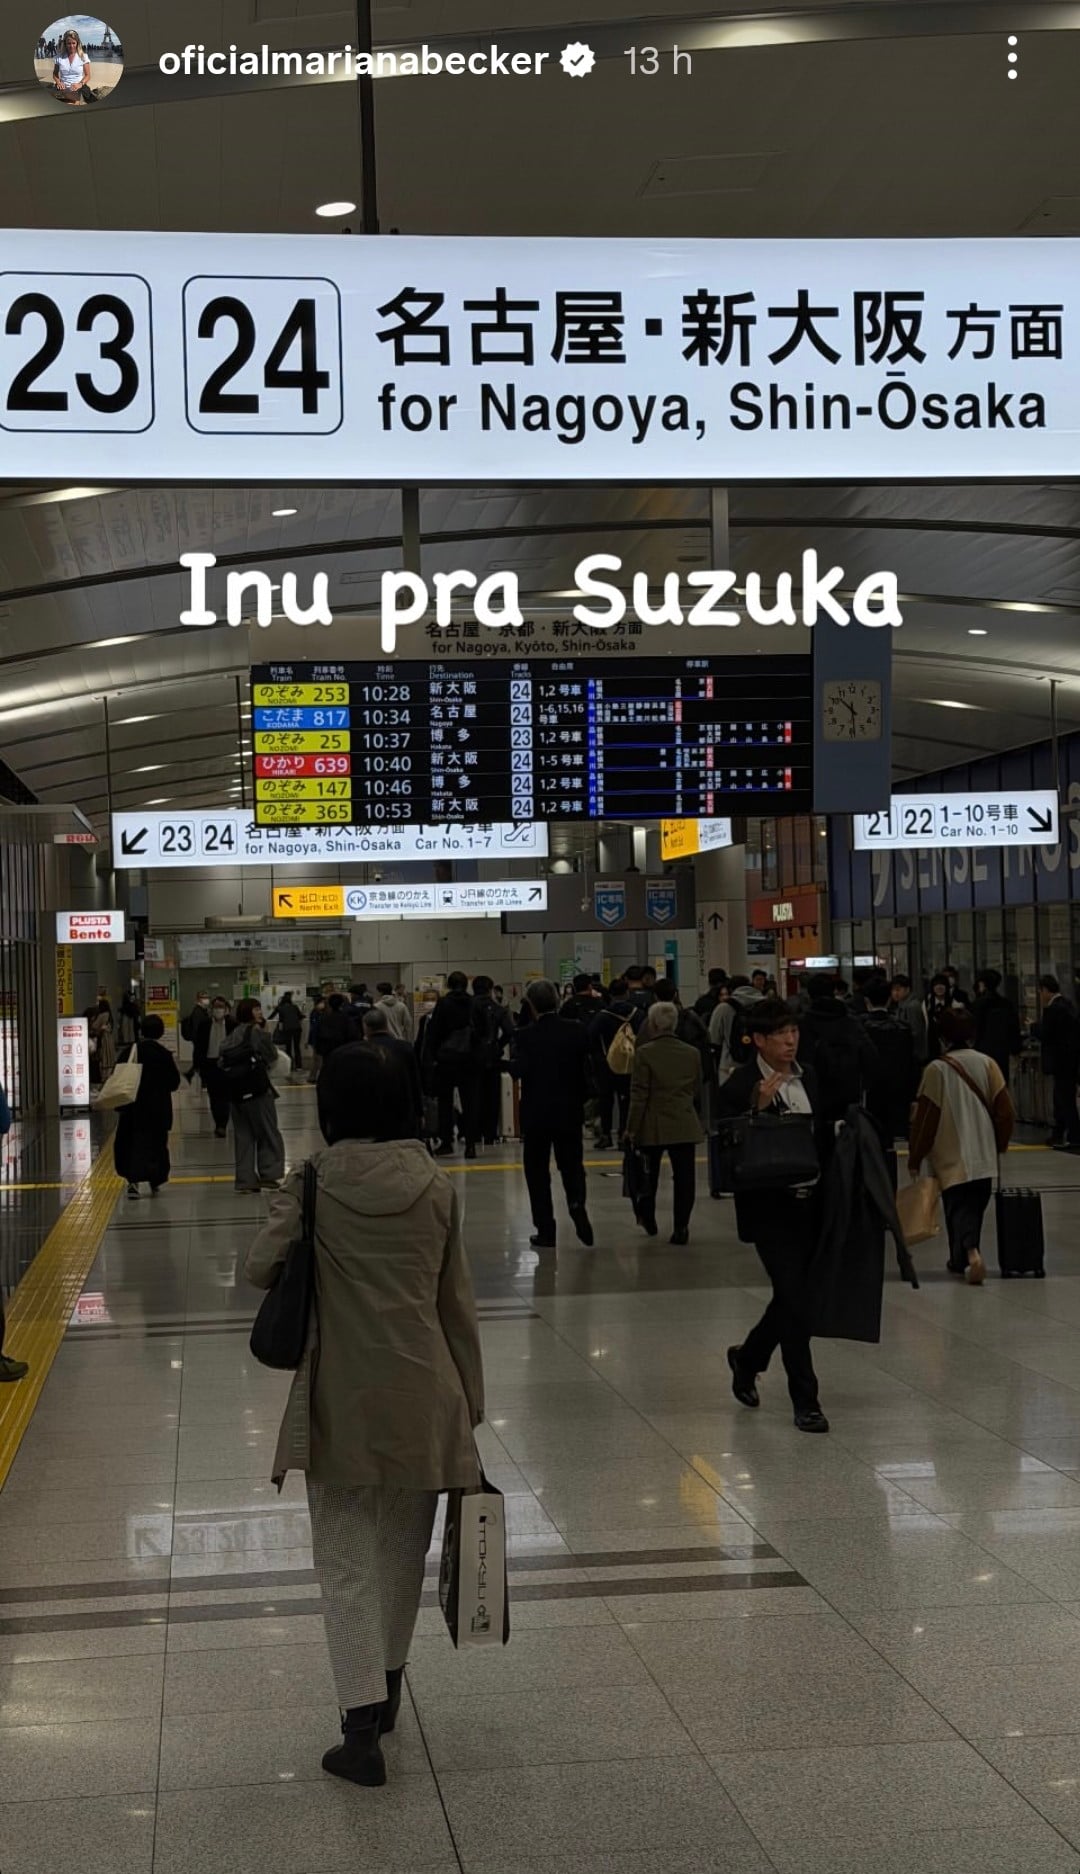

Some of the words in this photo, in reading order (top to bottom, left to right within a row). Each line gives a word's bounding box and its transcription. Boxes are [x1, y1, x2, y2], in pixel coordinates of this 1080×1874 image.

[946, 302, 1064, 360] 方面
[5, 292, 139, 414] 23
[198, 296, 329, 414] 24
[378, 383, 457, 431] for
[481, 382, 706, 444] Nagoya,
[730, 371, 1046, 431] Shin-Ōsaka
[432, 642, 453, 654] for
[456, 641, 512, 656] Nagoya,
[260, 686, 304, 698] のぞみ
[313, 687, 346, 702] 253
[362, 686, 411, 702] 10:28
[513, 682, 531, 700] 24
[539, 685, 556, 697] 1,2
[559, 685, 582, 696] 号車
[262, 708, 304, 722] こだま
[513, 706, 531, 723] 24
[539, 703, 584, 716] 1-6,15,16
[314, 710, 346, 725] 817
[363, 710, 411, 725] 10:34
[261, 733, 306, 745] のぞみ
[320, 735, 341, 750] 25
[363, 734, 411, 748] 10:37
[513, 728, 531, 746] 23
[540, 731, 556, 744] 1,2
[560, 731, 582, 743] 号車
[262, 756, 306, 769] ひかり
[314, 757, 348, 773] 639
[364, 757, 412, 772] 10:40
[513, 752, 531, 770] 24
[540, 755, 557, 766] 1-5
[561, 754, 584, 766] 号車
[262, 779, 306, 792] のぞみ
[317, 781, 348, 796] 147
[364, 780, 412, 795] 10:46
[513, 775, 531, 793] 24
[540, 777, 557, 790] 1,2
[560, 777, 583, 789] 号車
[263, 803, 306, 816] のぞみ
[316, 804, 349, 820] 365
[365, 803, 412, 819] 10:53
[513, 798, 532, 816] 24
[540, 800, 557, 813] 1,2
[560, 800, 583, 812] 号車
[868, 812, 892, 836] 21
[904, 808, 933, 835] 22
[204, 824, 235, 851] 24
[941, 826, 962, 837] Car
[966, 825, 987, 836] No.
[991, 824, 1018, 836] 1-10
[162, 825, 192, 852] 23
[415, 838, 438, 850] Car
[442, 837, 464, 850] No.
[467, 836, 492, 849] 1-7
[245, 842, 263, 854] for
[268, 841, 322, 856] Nagoya,
[71, 917, 109, 926] PLUSTA
[69, 929, 111, 939] Bento
